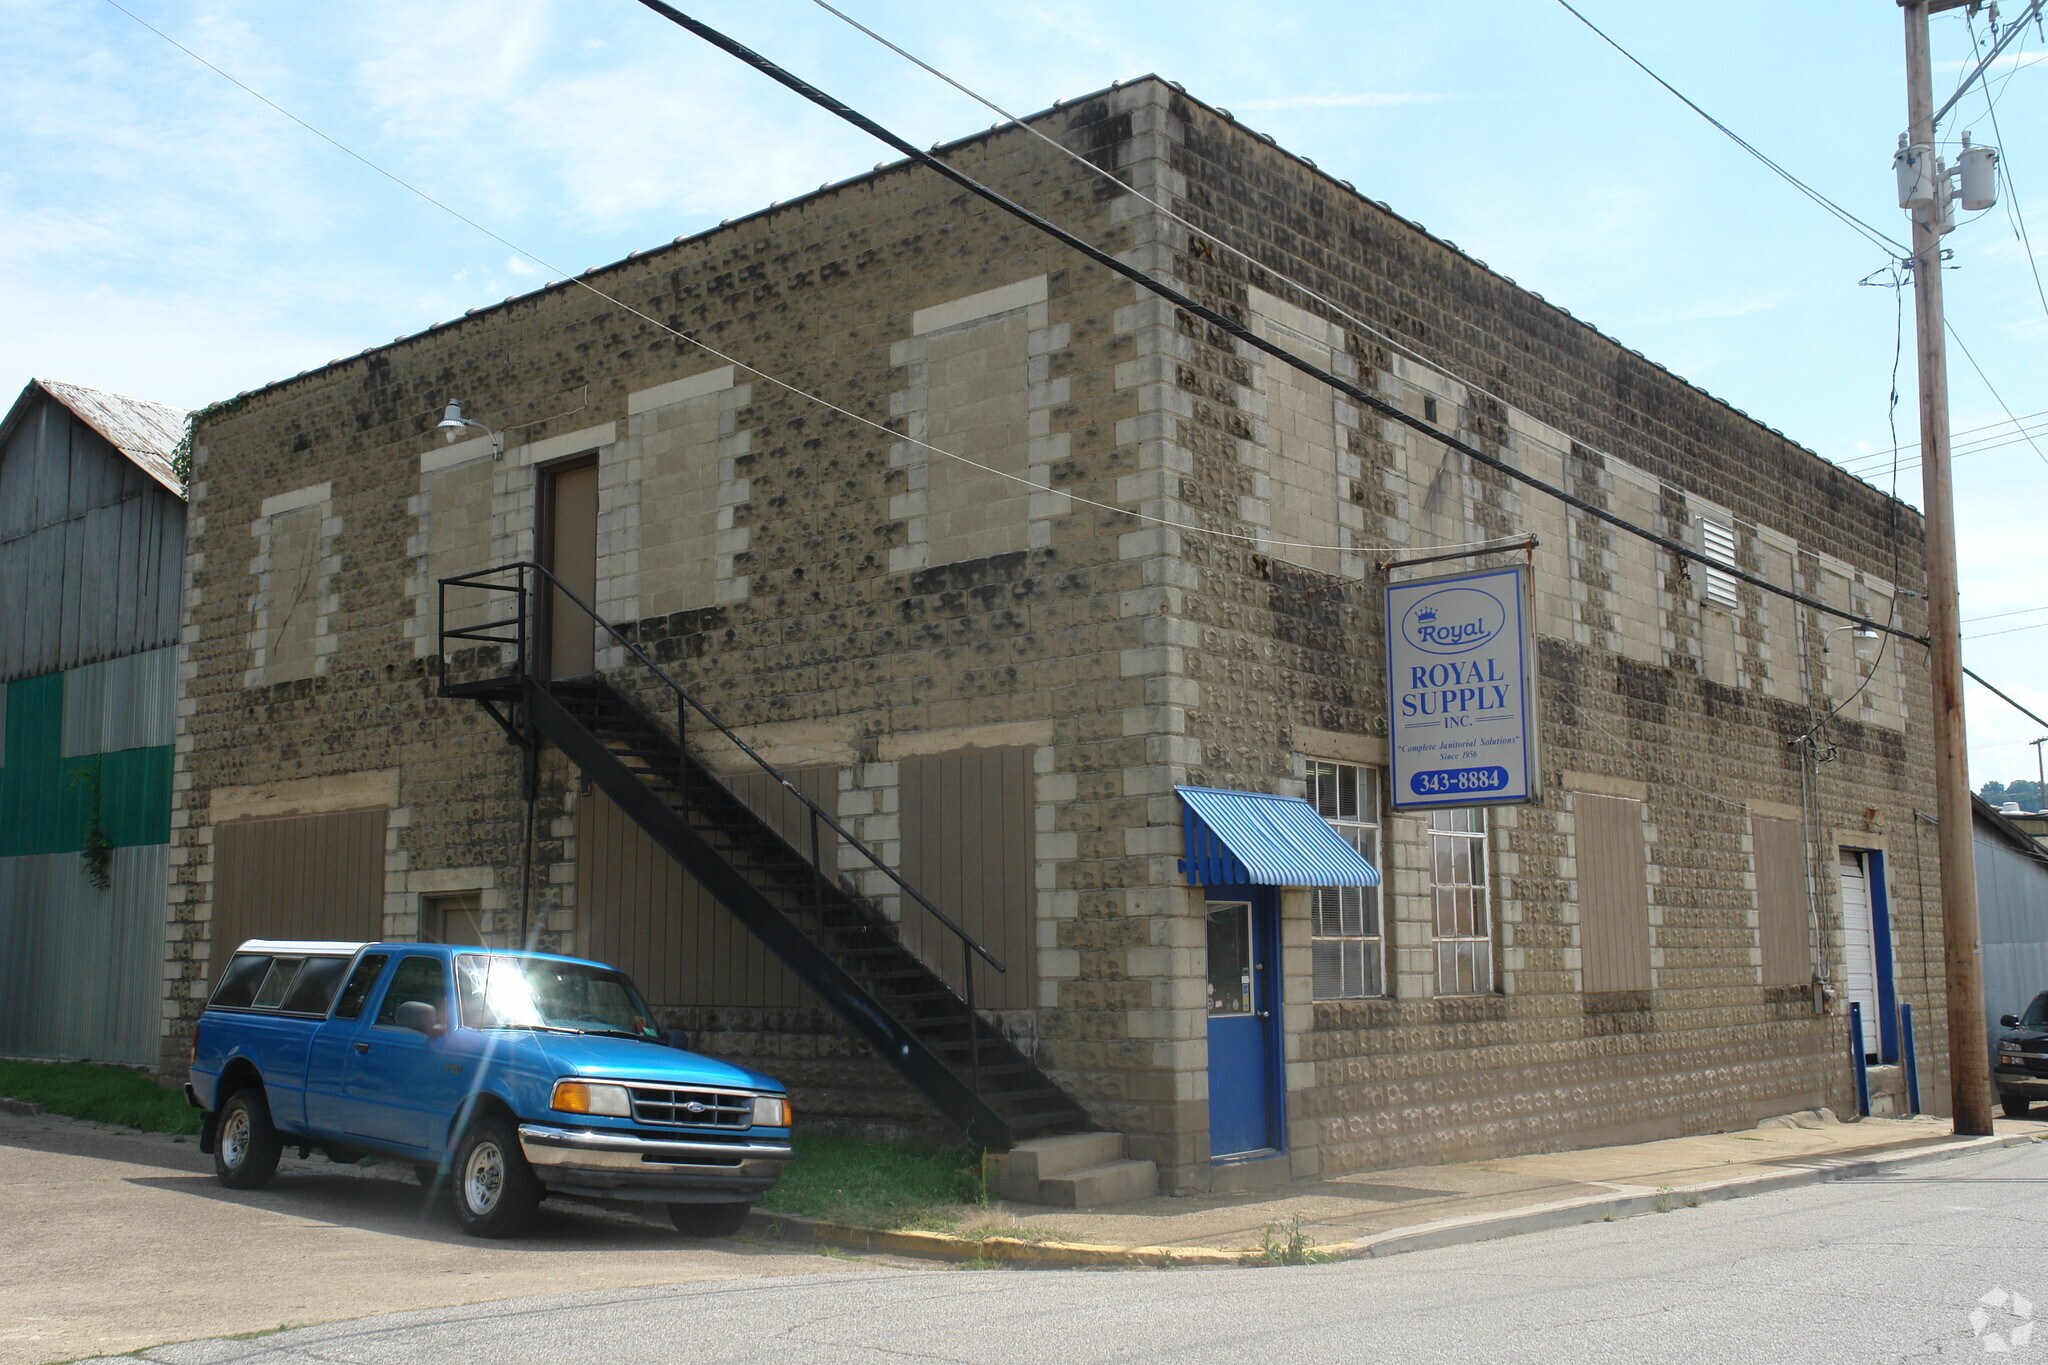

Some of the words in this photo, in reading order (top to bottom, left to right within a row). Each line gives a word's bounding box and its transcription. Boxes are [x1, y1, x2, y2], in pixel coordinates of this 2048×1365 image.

[1417, 617, 1491, 645] Royal
[1410, 658, 1504, 689] ROYAL
[1402, 684, 1510, 717] SUPPLY
[1444, 715, 1473, 729] INC.
[1439, 739, 1476, 750] Janitorial
[1439, 753, 1459, 761] Since
[1462, 751, 1478, 759] 1956
[1419, 769, 1499, 792] 343-8884
